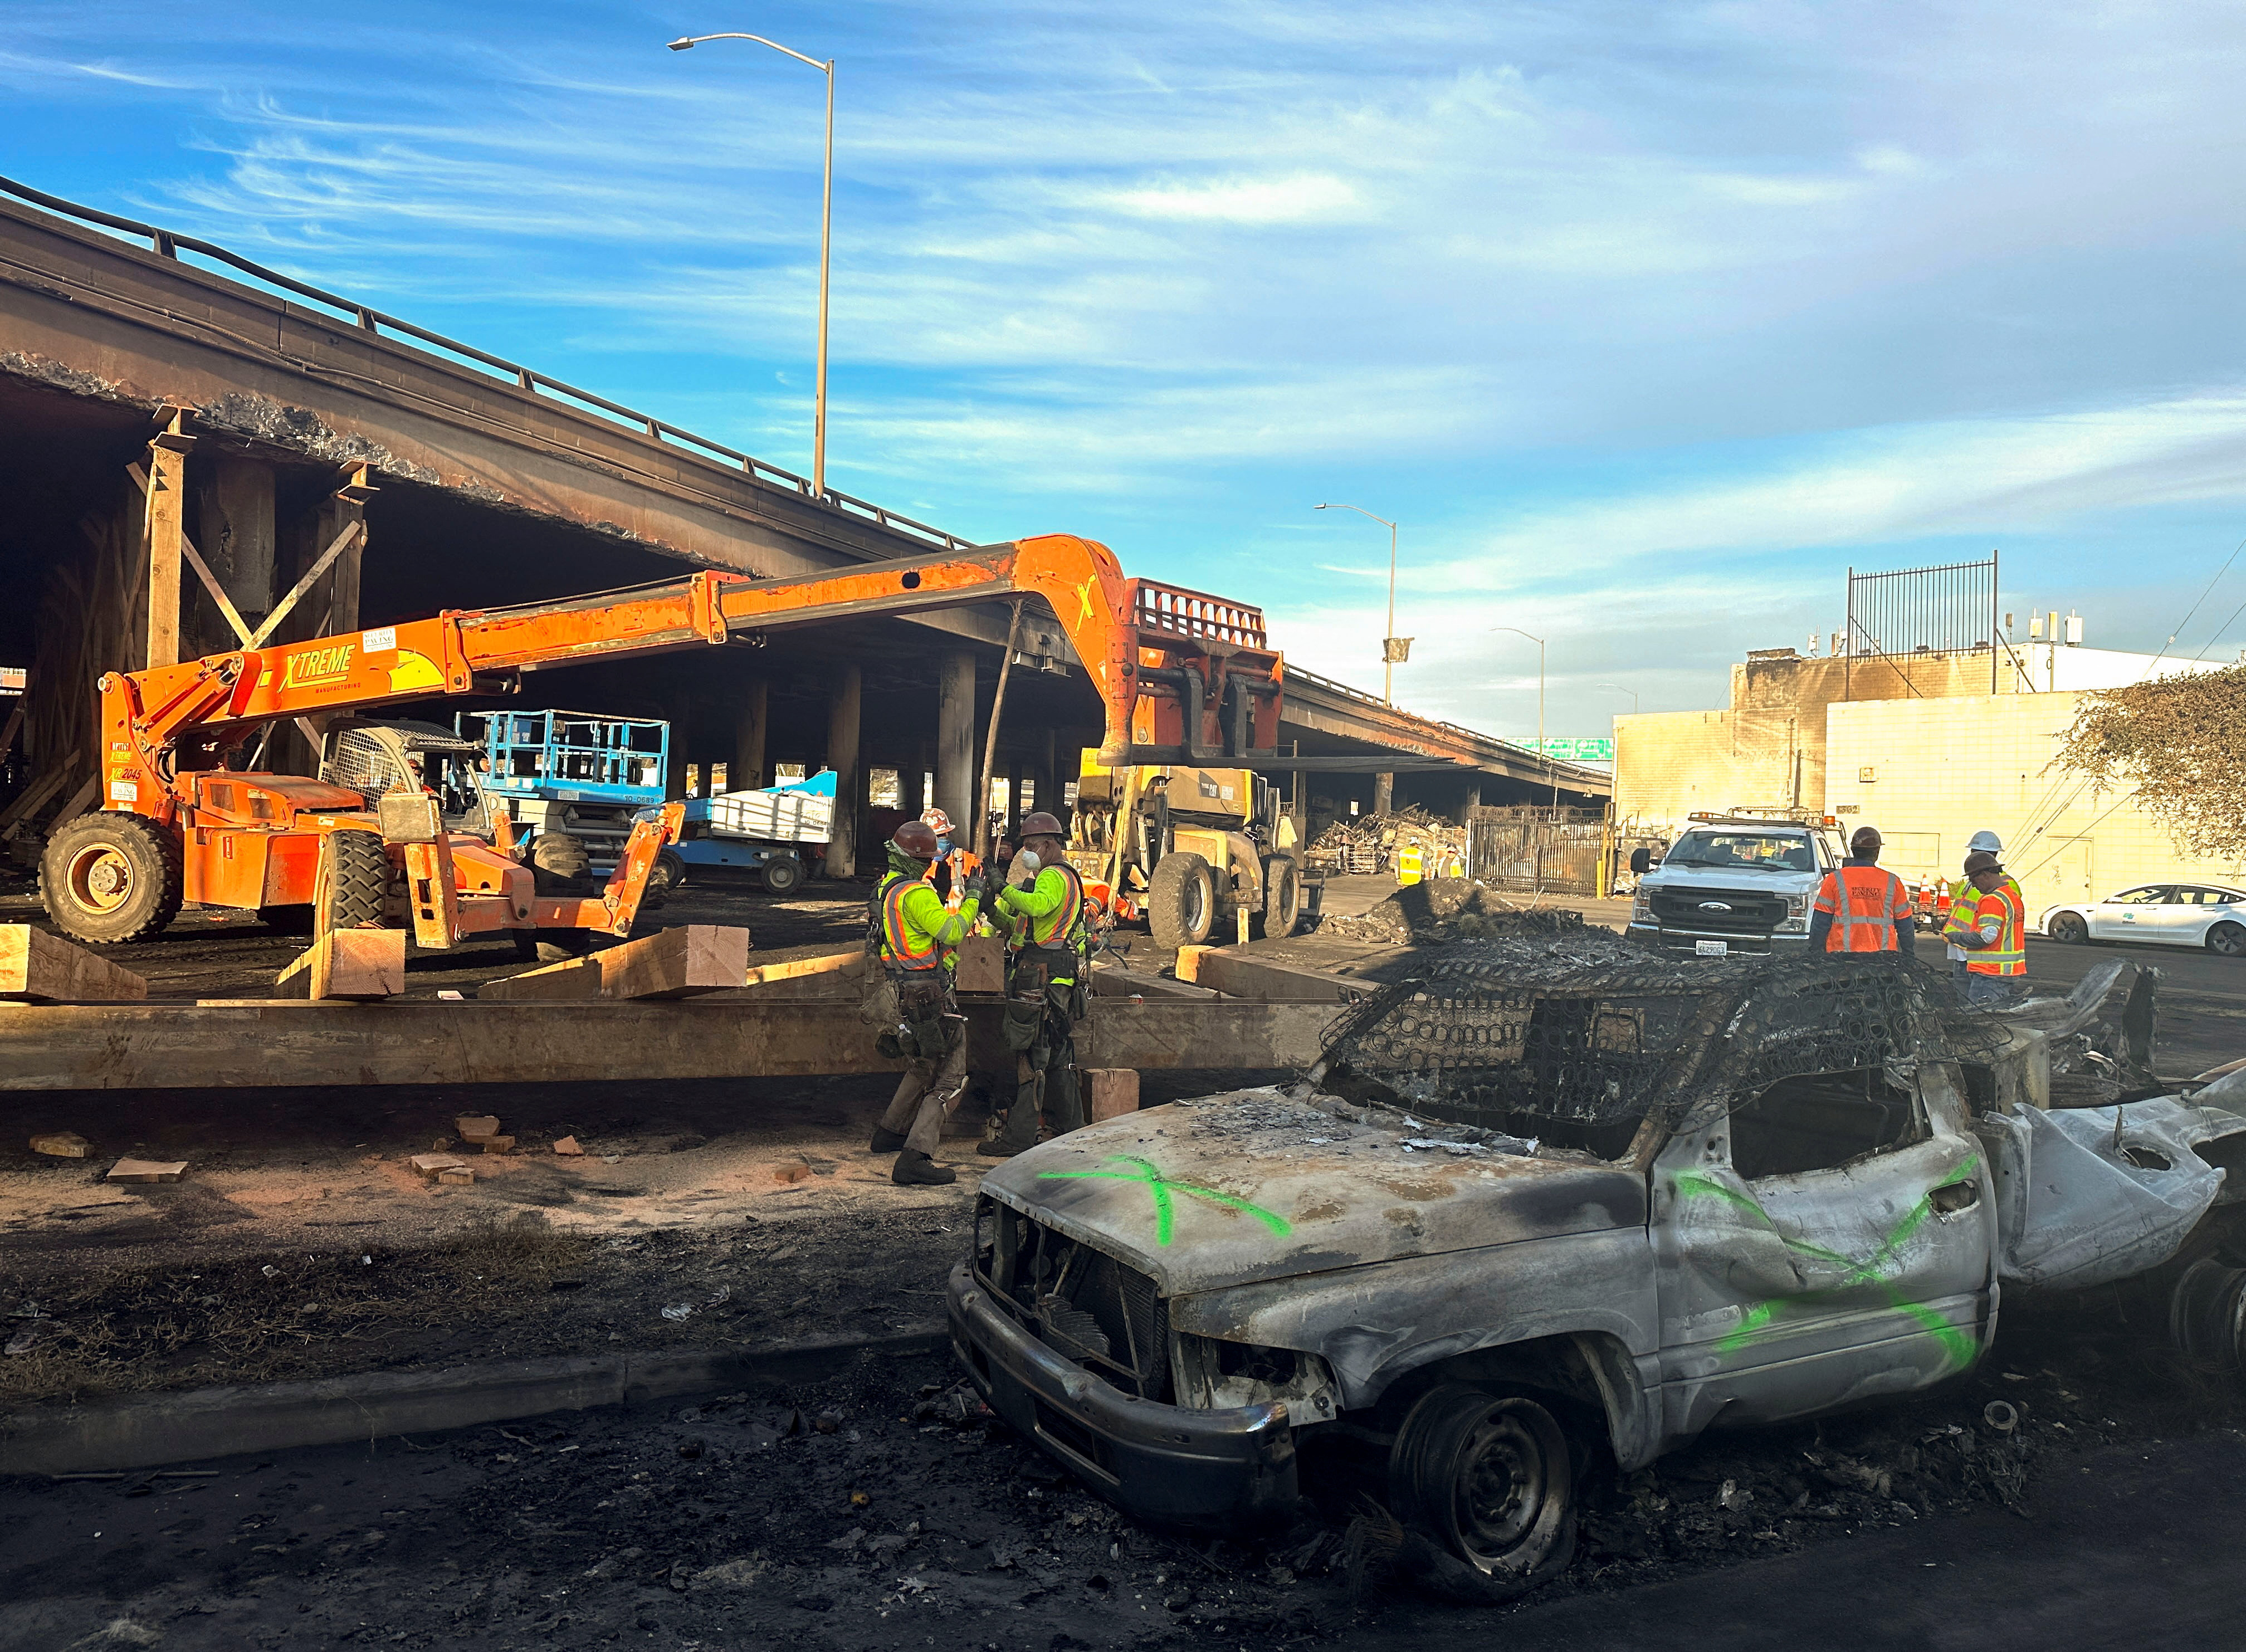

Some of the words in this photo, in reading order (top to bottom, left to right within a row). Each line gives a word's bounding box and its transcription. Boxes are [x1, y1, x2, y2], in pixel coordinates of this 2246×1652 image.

[276, 643, 357, 693] XTREME
[315, 682, 361, 694] MANUFACTURING
[108, 751, 133, 764] XTREME
[121, 768, 143, 780] 2045
[1209, 784, 1218, 797] CAT
[624, 795, 655, 804] 10-0689
